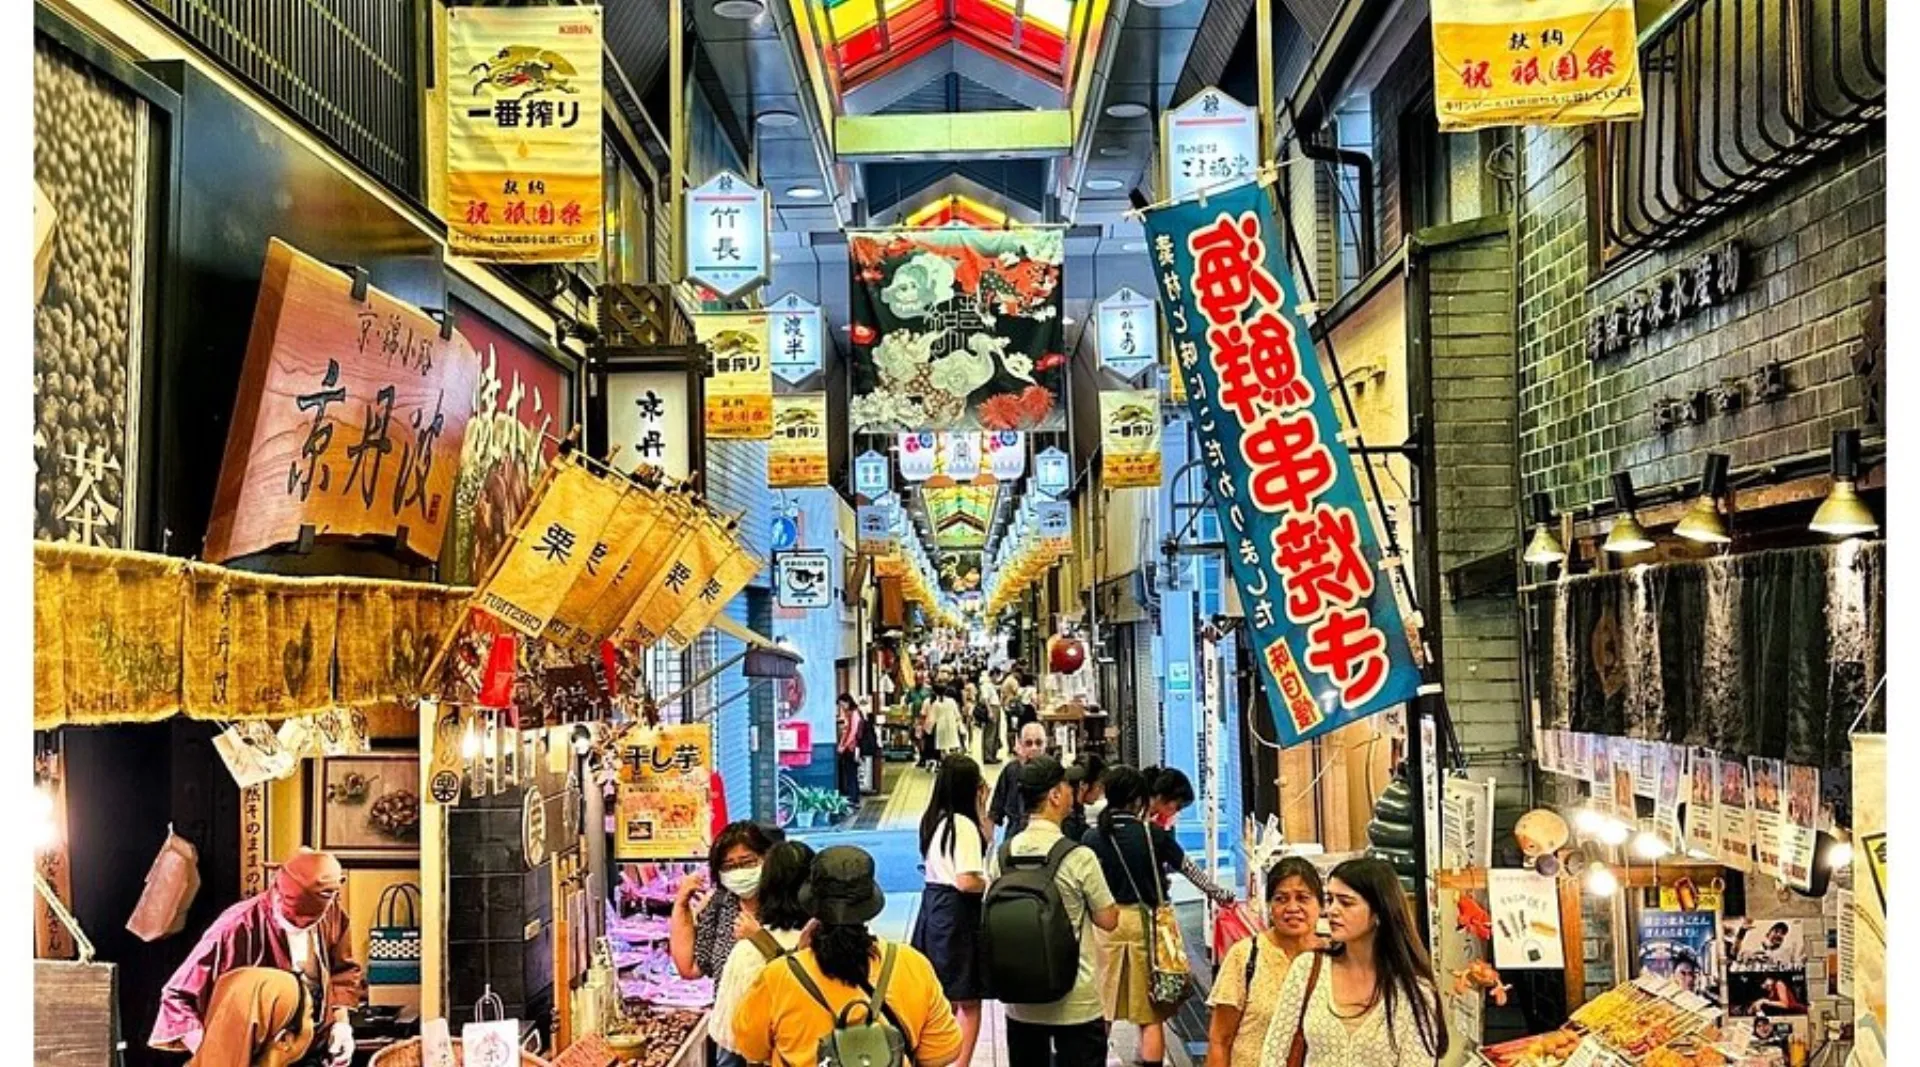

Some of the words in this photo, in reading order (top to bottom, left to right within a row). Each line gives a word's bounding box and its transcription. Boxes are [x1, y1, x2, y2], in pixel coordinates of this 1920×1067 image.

[558, 24, 593, 35] KIRIN
[1461, 58, 1493, 89] 祝
[1510, 45, 1617, 85] 祇園祭
[468, 99, 579, 128] 一番搾り
[466, 200, 491, 225] 祝
[710, 207, 741, 261] 竹長
[715, 355, 760, 373] 番搾り
[287, 358, 444, 520] 京丹波
[635, 390, 666, 478] 京丹
[56, 441, 121, 549] 茶
[624, 744, 702, 774] 干し芋
